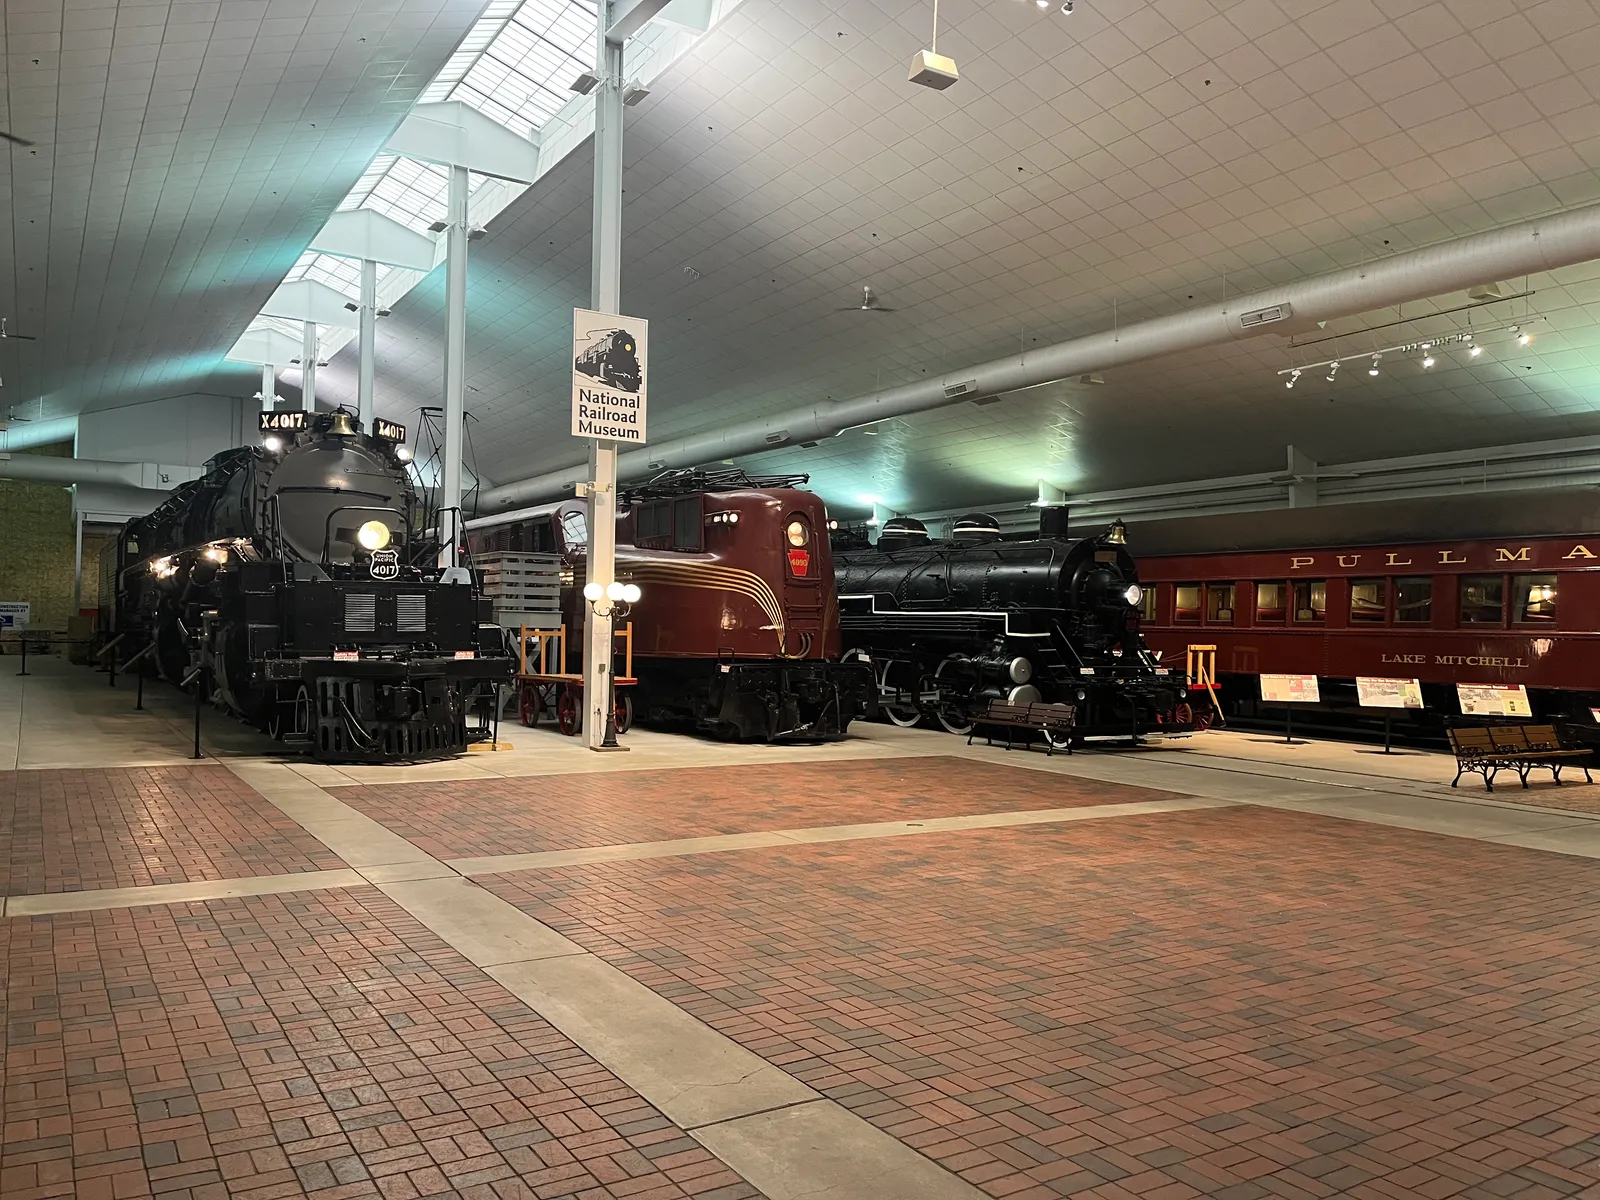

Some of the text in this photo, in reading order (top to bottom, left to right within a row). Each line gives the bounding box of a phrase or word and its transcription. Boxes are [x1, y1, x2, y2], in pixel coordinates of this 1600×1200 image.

[580, 388, 640, 408] National
[261, 413, 303, 429] X4017
[579, 404, 637, 424] Railroad
[379, 421, 404, 440] X4017
[579, 420, 639, 439] Museum
[373, 565, 395, 574] 4017
[1381, 654, 1530, 668] LAKE MITCHELL
